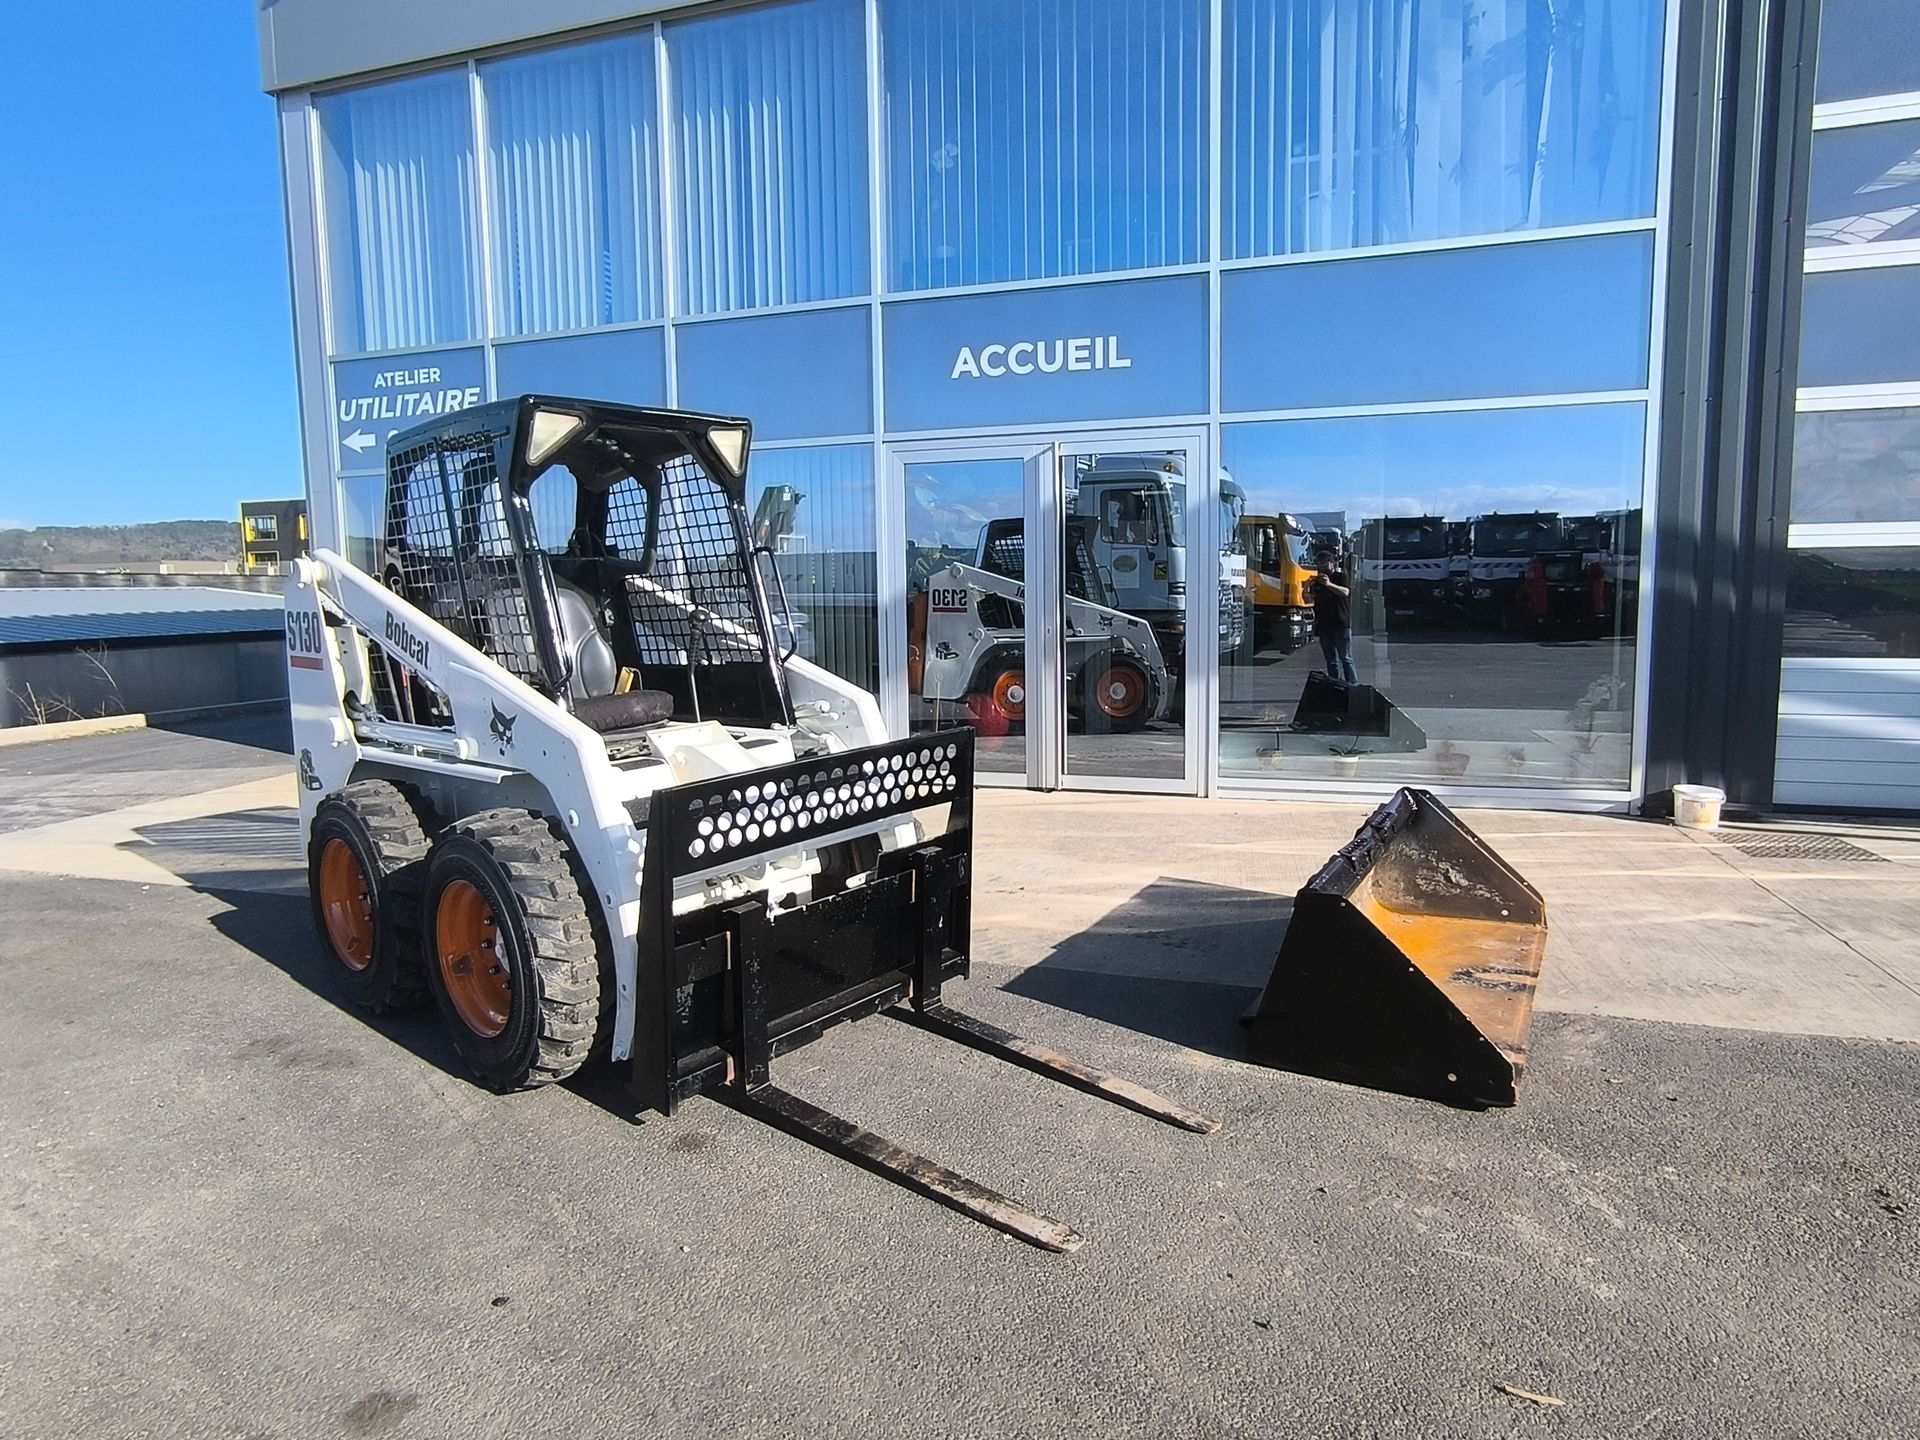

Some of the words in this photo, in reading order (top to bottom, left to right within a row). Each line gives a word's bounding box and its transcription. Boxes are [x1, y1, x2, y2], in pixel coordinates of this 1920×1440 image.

[374, 367, 441, 389] ATELIER
[951, 336, 1132, 379] ACCUEIL
[340, 387, 480, 421] UTILITAIRE
[286, 610, 322, 654] S130
[385, 610, 430, 670] Bobcat
